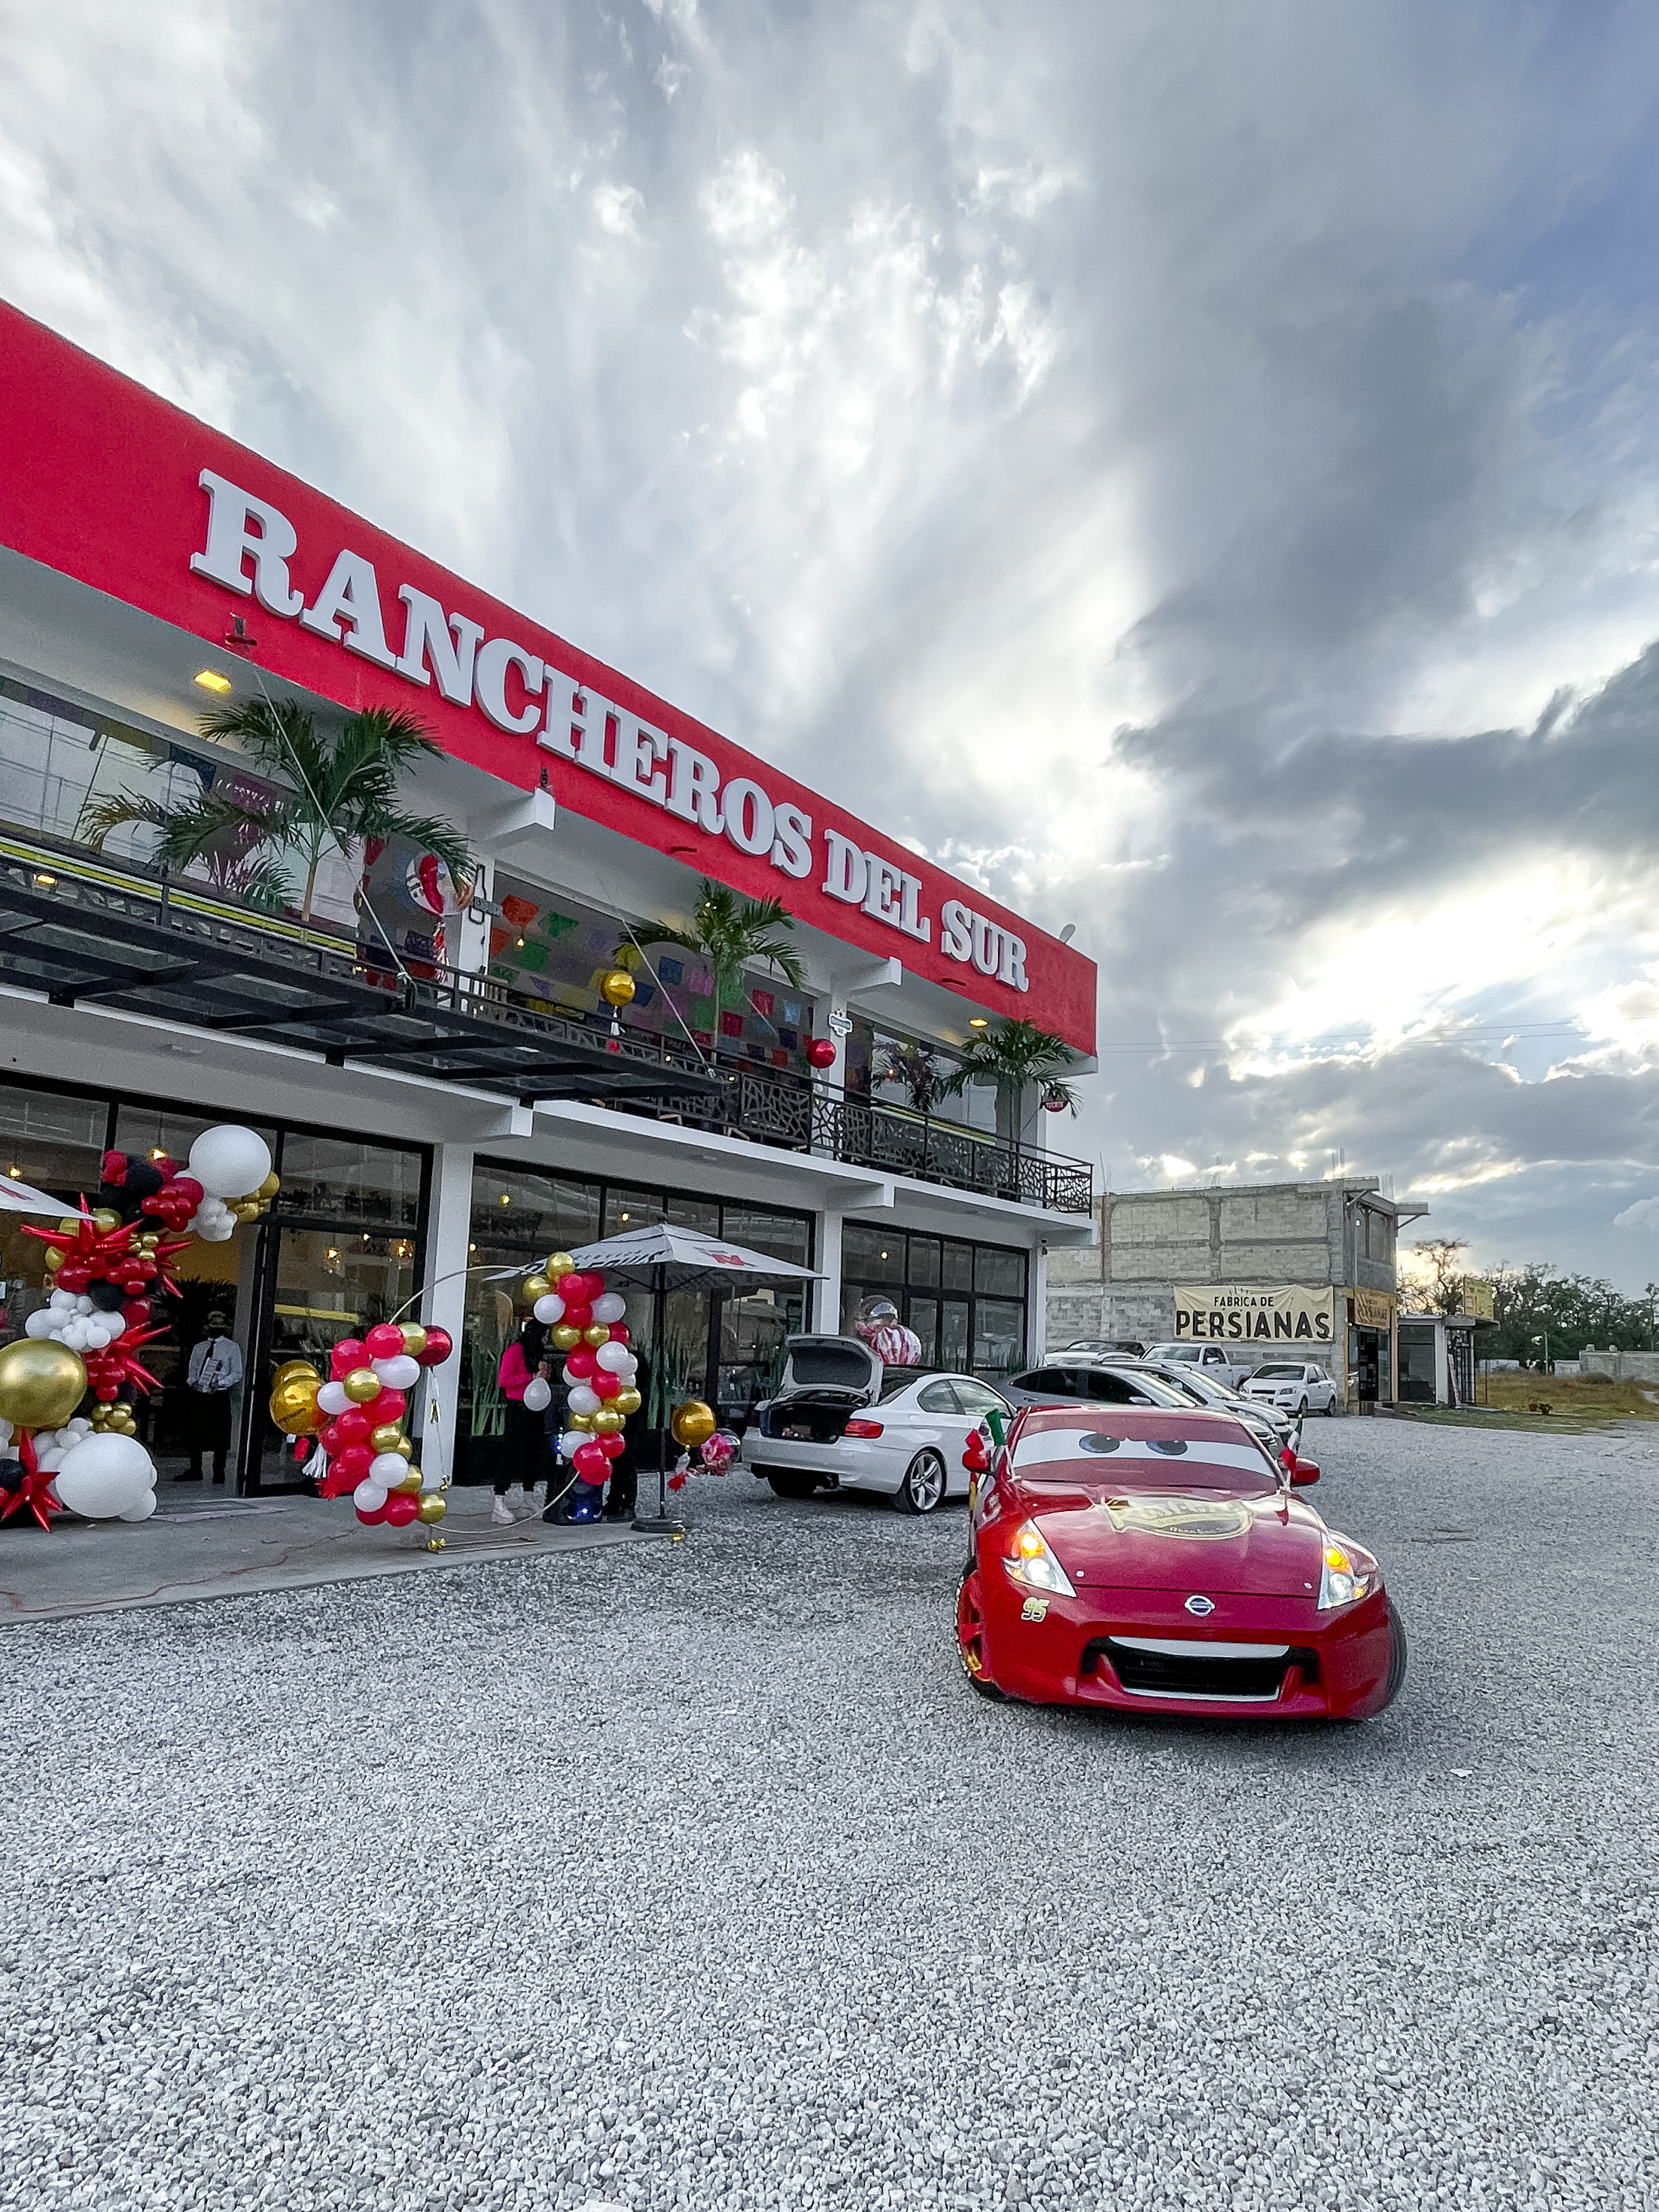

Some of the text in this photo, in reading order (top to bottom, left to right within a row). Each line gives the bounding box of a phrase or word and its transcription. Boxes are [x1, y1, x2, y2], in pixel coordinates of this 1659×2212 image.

[190, 468, 1030, 993] RANCHEROS DEL SUR
[1213, 1296, 1275, 1307] FABRICA DE
[1175, 1309, 1331, 1340] PERSIANAS
[1020, 1596, 1051, 1622] 95
